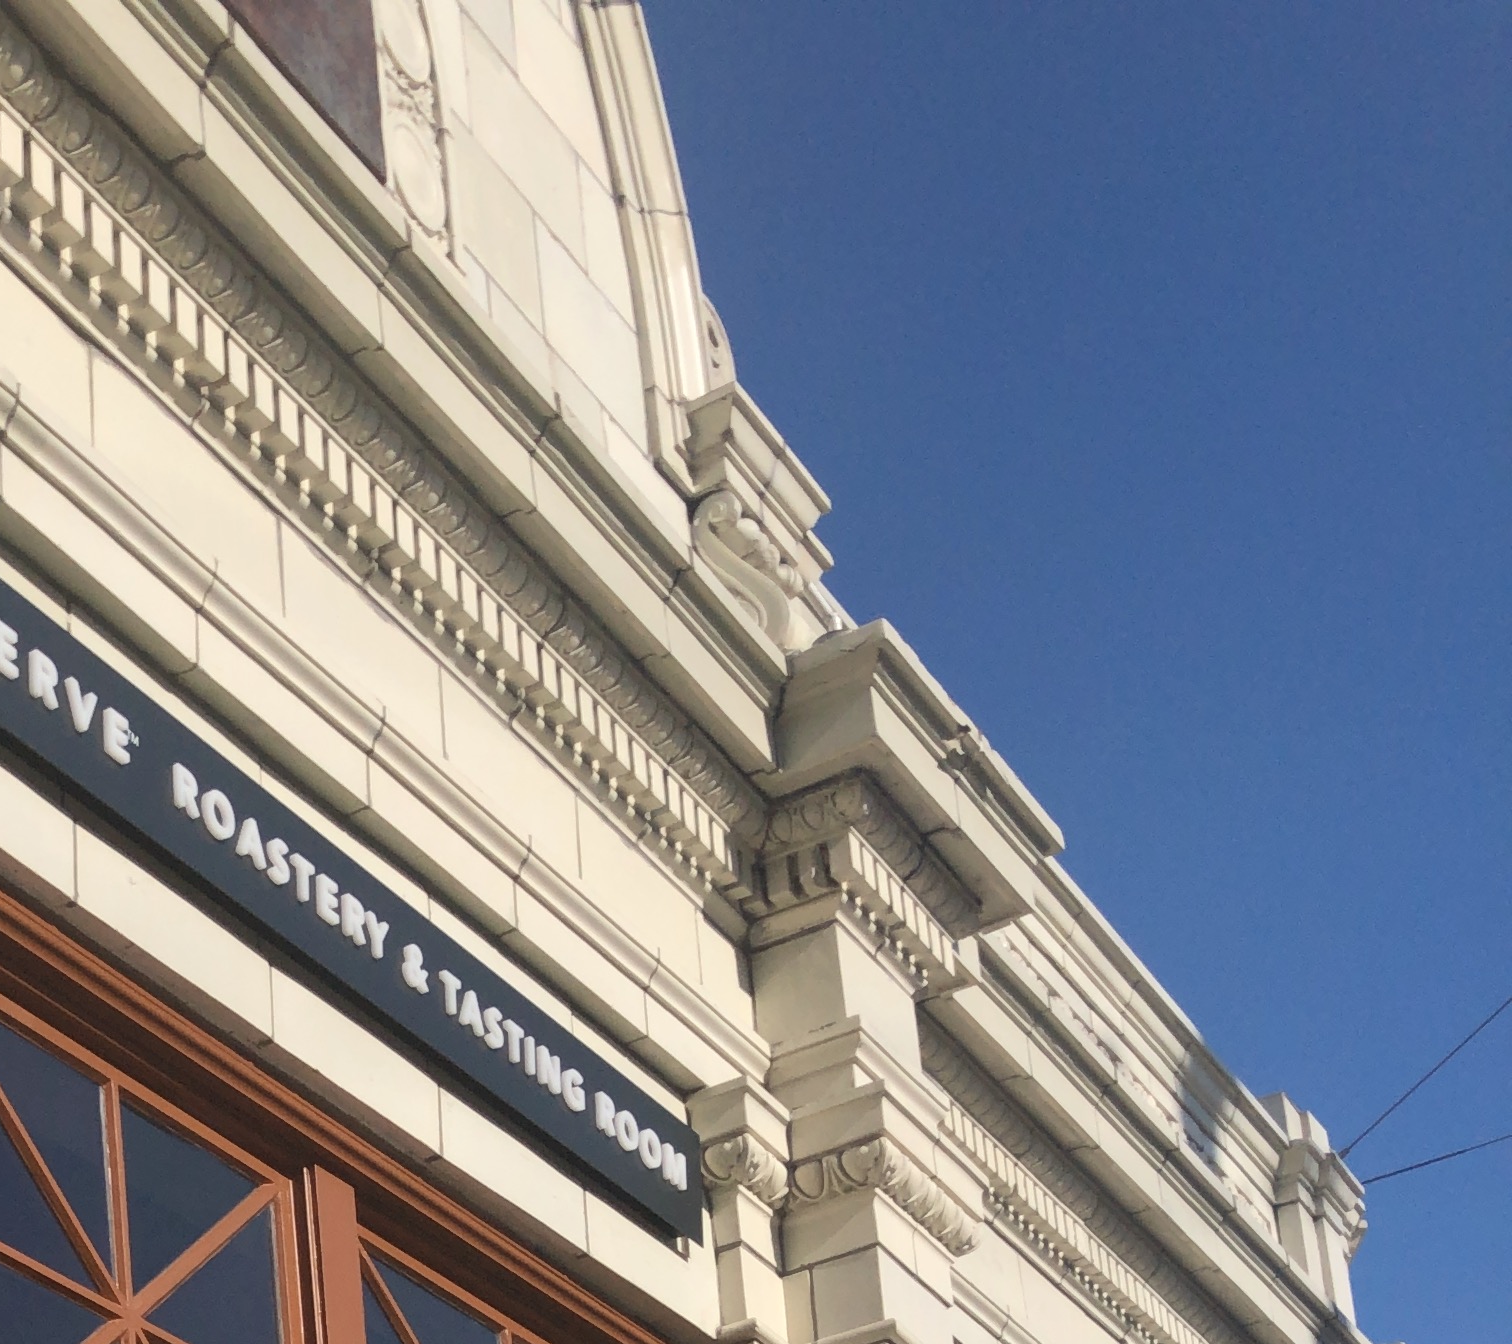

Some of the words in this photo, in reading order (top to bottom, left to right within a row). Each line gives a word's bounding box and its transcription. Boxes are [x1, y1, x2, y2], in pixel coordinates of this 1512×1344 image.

[172, 762, 389, 960] ROASTERY
[402, 943, 429, 995] &
[439, 969, 586, 1112] TASTING
[595, 1091, 688, 1191] ROOM
